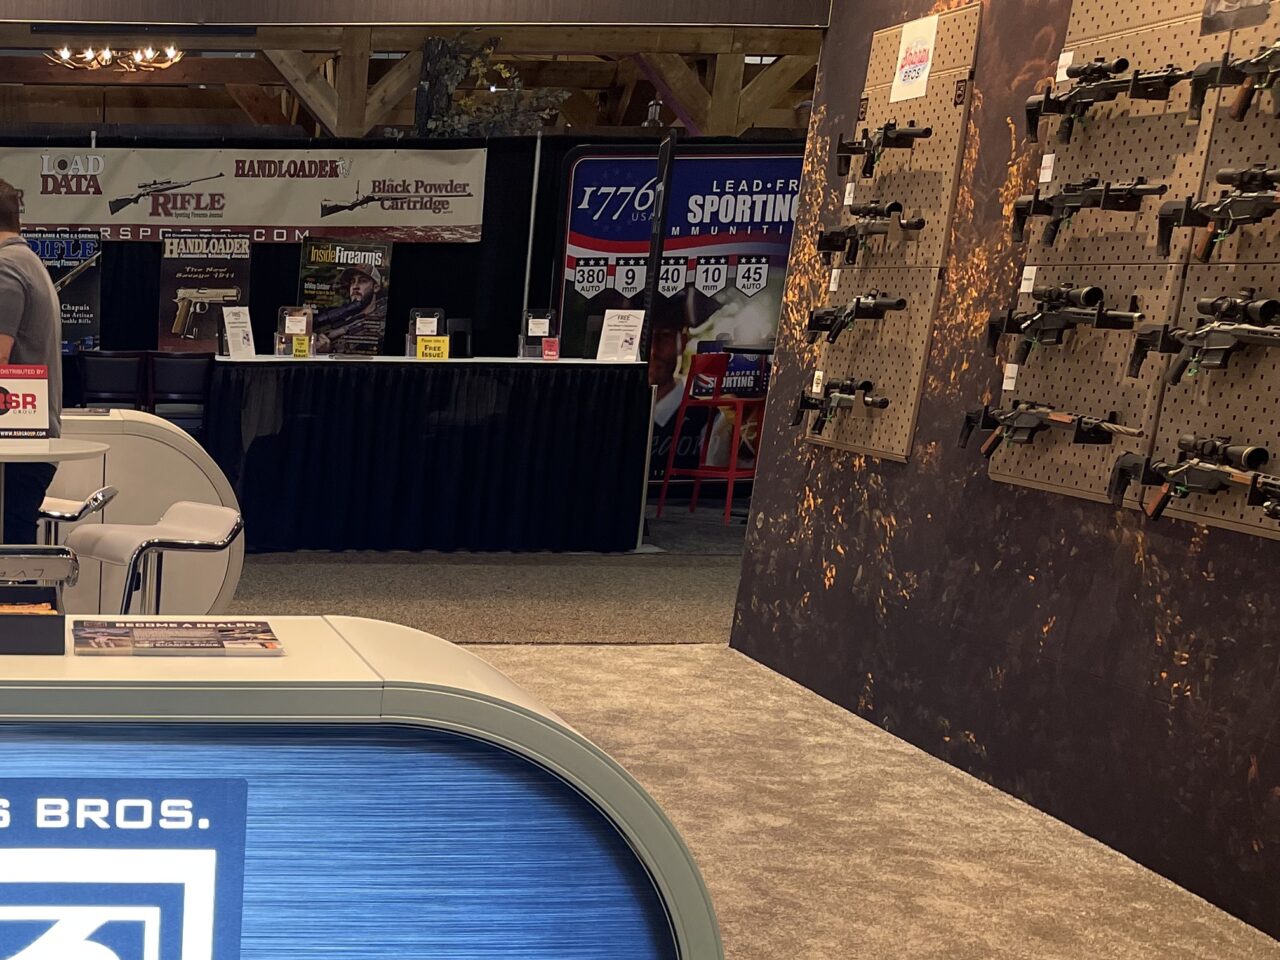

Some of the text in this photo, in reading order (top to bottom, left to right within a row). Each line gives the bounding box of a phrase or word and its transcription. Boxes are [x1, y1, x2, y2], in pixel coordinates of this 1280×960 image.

[40, 154, 105, 175] LOAD
[234, 159, 339, 179] HANDLOADER
[40, 174, 103, 195] DATA
[371, 178, 470, 194] Black Powder
[149, 192, 226, 217] RIFLE
[380, 197, 450, 214] Cartridge
[577, 177, 658, 220] 1776
[164, 238, 250, 258] HANDLOADER
[576, 268, 606, 284] 380
[624, 268, 636, 285] 9
[659, 267, 680, 283] 40
[701, 266, 721, 283] 10
[741, 266, 763, 282] 45
[61, 303, 90, 312] Chapuis
[36, 798, 211, 829] BROS.
